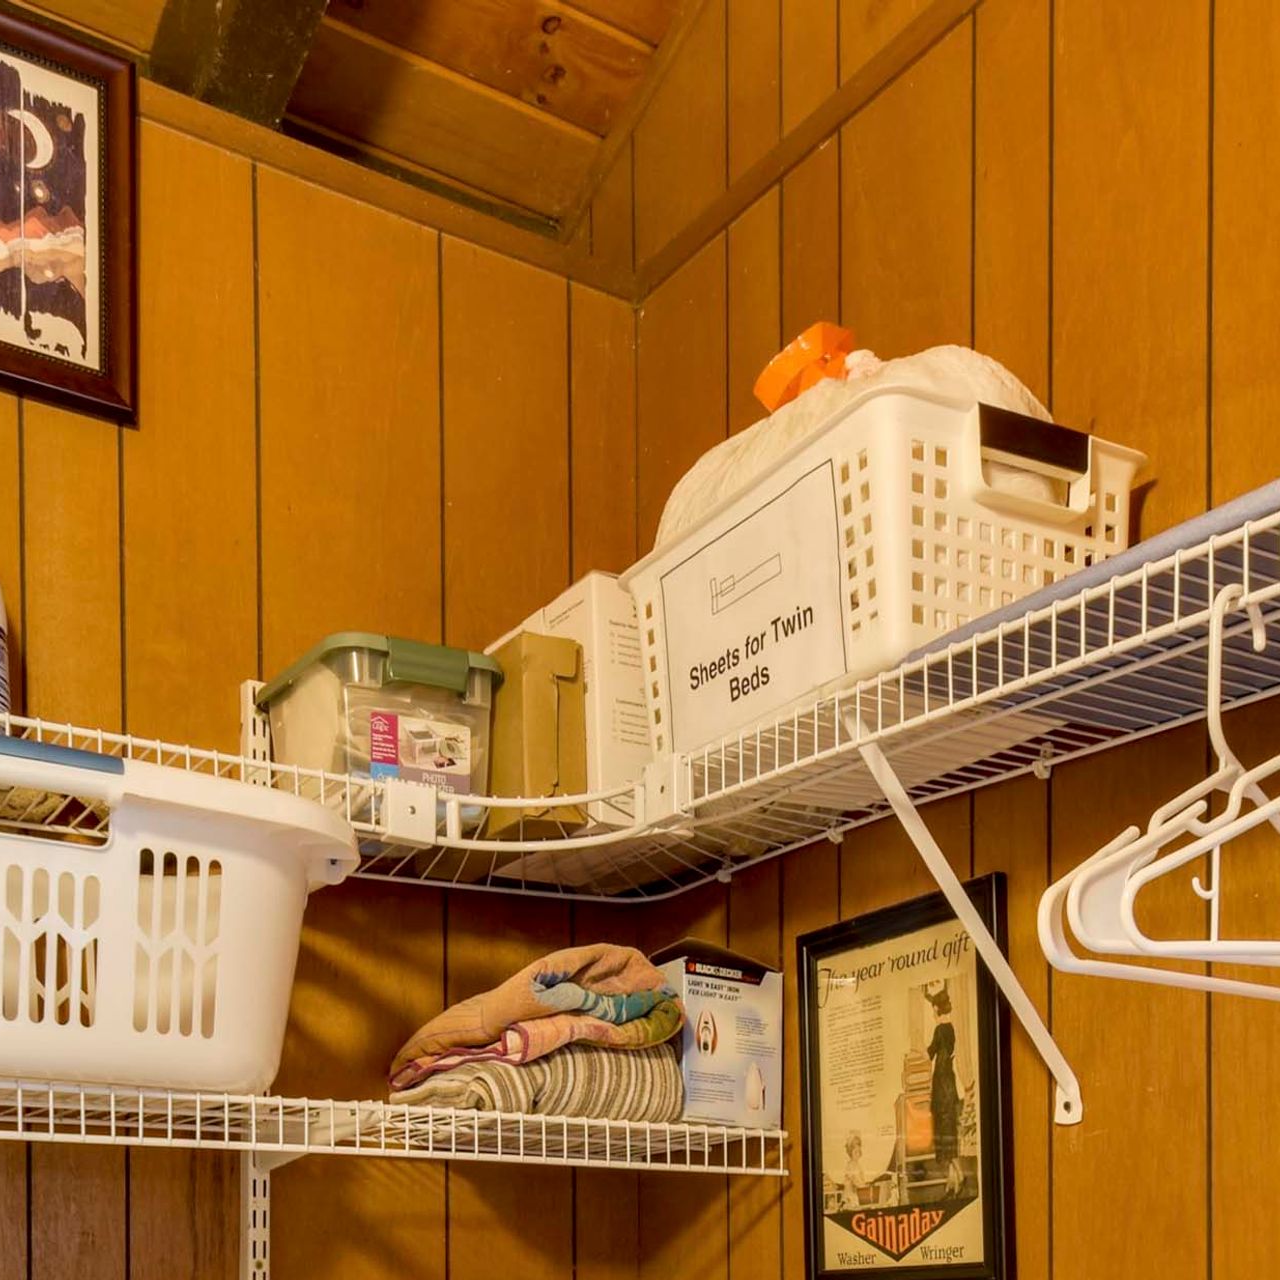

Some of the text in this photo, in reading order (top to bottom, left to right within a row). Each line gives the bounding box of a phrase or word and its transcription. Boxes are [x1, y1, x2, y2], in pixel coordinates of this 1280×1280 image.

[689, 605, 813, 690] Sheets for Twin
[729, 665, 770, 702] Beds
[851, 961, 886, 993] year
[888, 939, 938, 972] 'round
[943, 930, 971, 969] gift
[687, 979, 703, 988] LIGHT
[701, 990, 717, 999] LIGHT
[851, 1207, 945, 1256] Gainaday
[837, 1252, 877, 1266] Washer
[920, 1244, 965, 1263] Wringer
